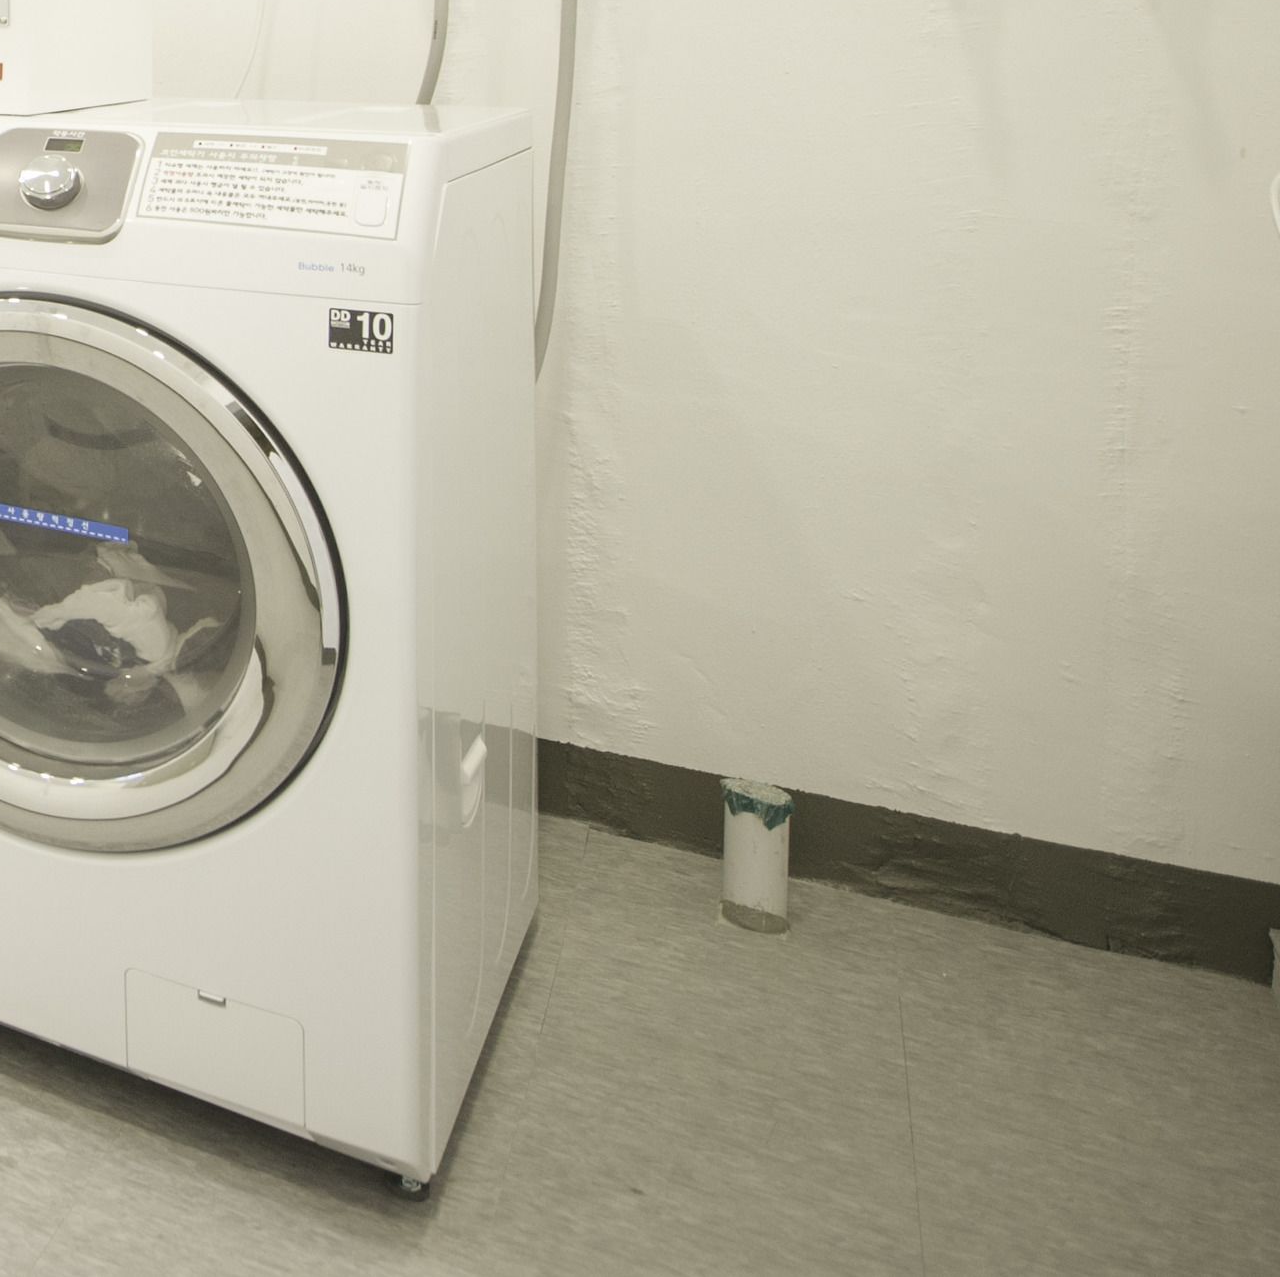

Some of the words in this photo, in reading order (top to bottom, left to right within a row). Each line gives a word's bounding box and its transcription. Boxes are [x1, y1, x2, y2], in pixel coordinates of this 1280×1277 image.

[340, 262, 366, 276] 14kg
[330, 310, 351, 322] DD
[356, 312, 392, 341] 10
[330, 342, 392, 354] WARRANTY
[362, 339, 392, 348] YEAR
